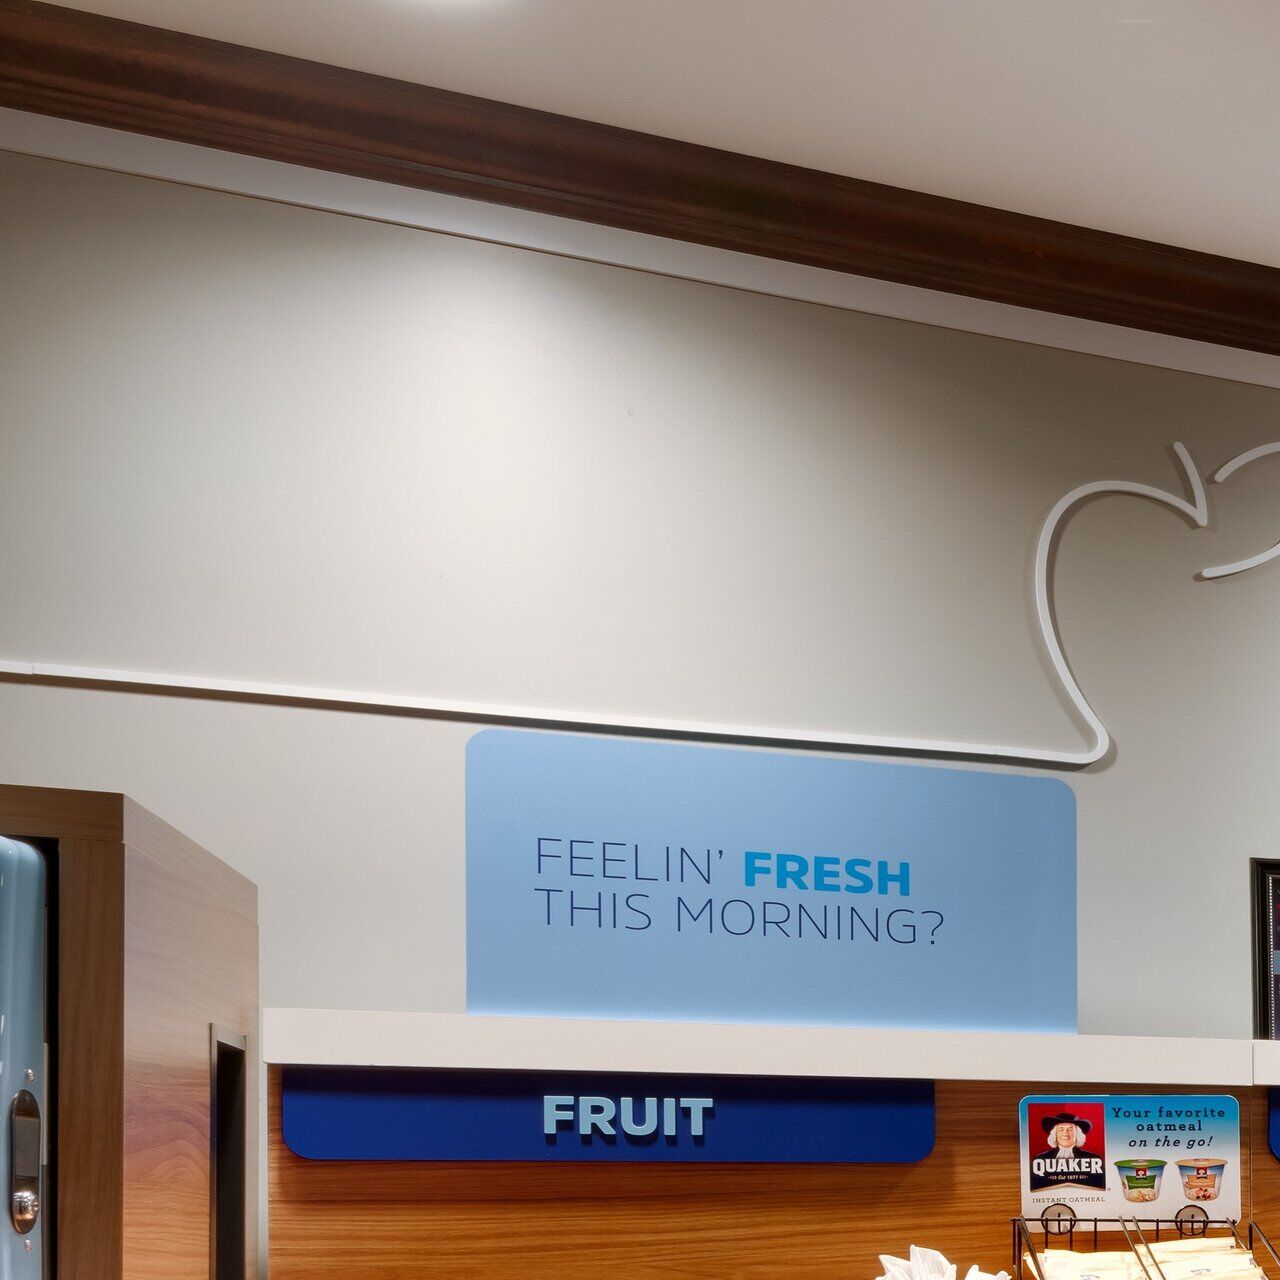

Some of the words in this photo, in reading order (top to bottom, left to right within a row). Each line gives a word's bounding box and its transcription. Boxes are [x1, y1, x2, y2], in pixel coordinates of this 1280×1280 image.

[535, 837, 725, 885] FEELIN'
[744, 850, 911, 897] FRESH
[534, 887, 653, 932] THIS
[675, 895, 945, 947] MORNING?
[543, 1095, 714, 1137] FRUIT
[1112, 1107, 1151, 1119] Your
[1158, 1106, 1226, 1119] favorite
[1136, 1119, 1203, 1132] oatmeal
[1129, 1138, 1147, 1148] on
[1155, 1136, 1180, 1148] the
[1186, 1136, 1214, 1149] go!
[1032, 1158, 1103, 1177] QUAKER
